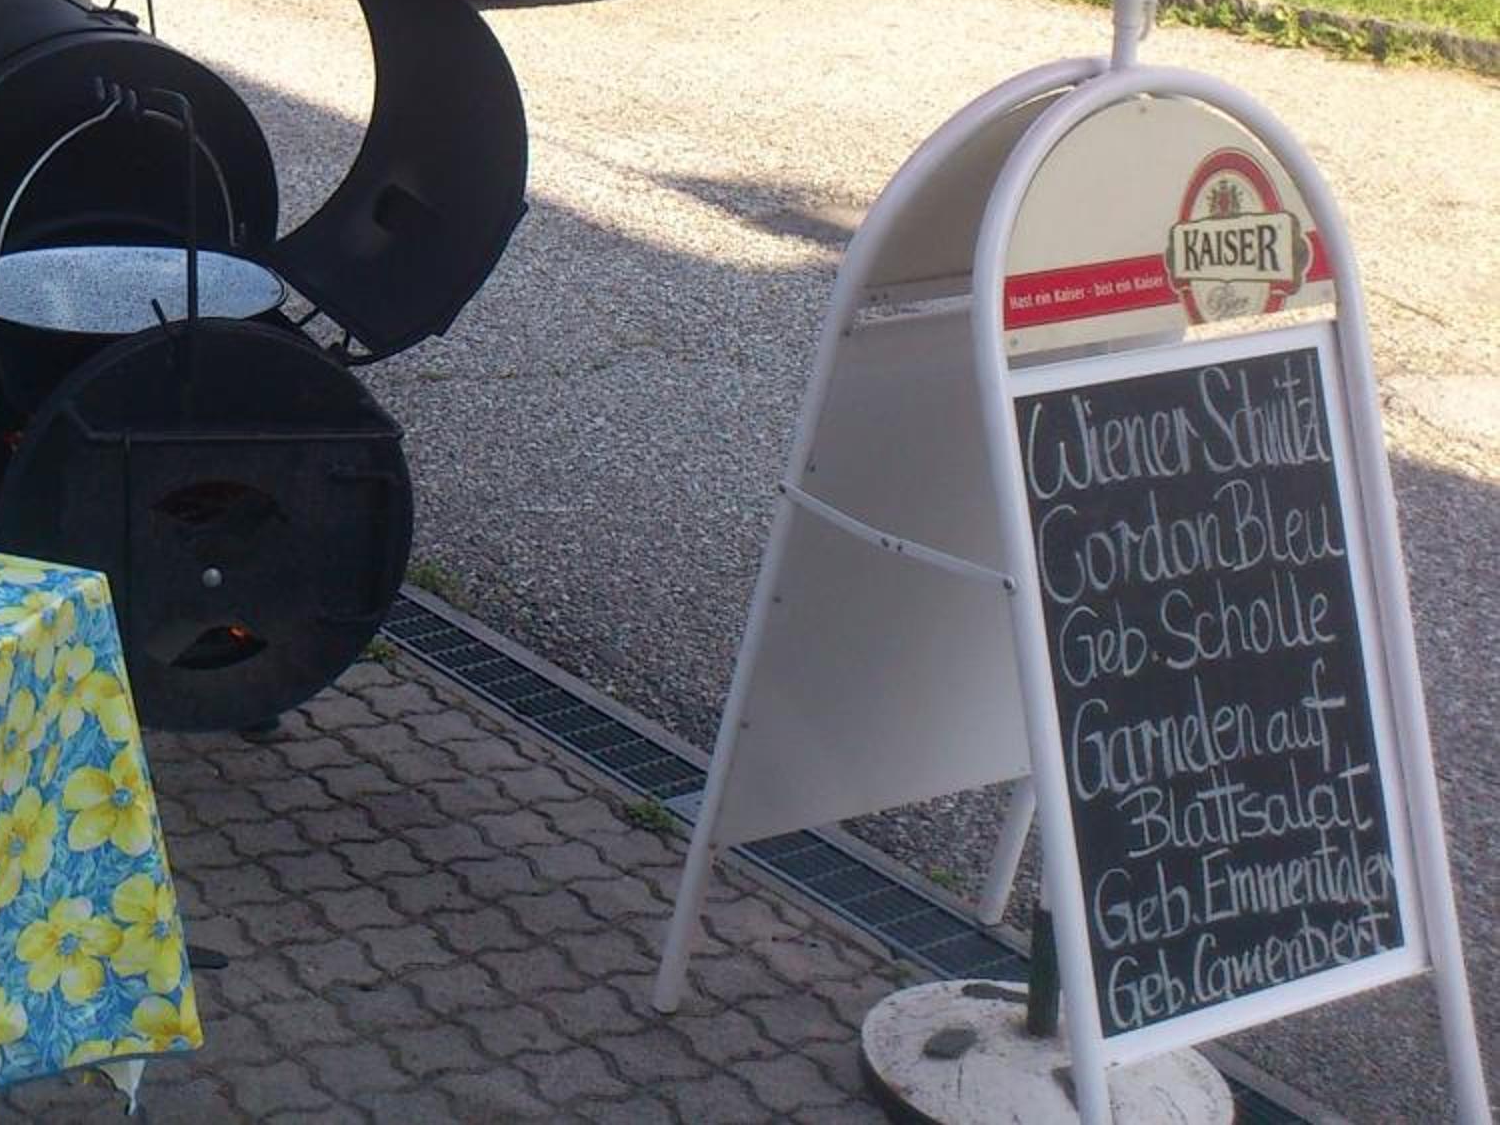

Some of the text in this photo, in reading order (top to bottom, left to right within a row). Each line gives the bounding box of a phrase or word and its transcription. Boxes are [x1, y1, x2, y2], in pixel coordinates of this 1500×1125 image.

[1054, 285, 1086, 303] Kaiser
[1134, 273, 1164, 290] Kaiser
[1182, 224, 1280, 272] KAISER
[1028, 394, 1199, 500] Wiener
[1213, 477, 1345, 573] Bleu
[1059, 570, 1336, 687] Geb. Scholle
[1072, 658, 1347, 802] Garnelen auf
[1116, 745, 1372, 859] Blattsalat
[1094, 860, 1202, 949] Geb.
[1108, 948, 1197, 1029] Geb.
